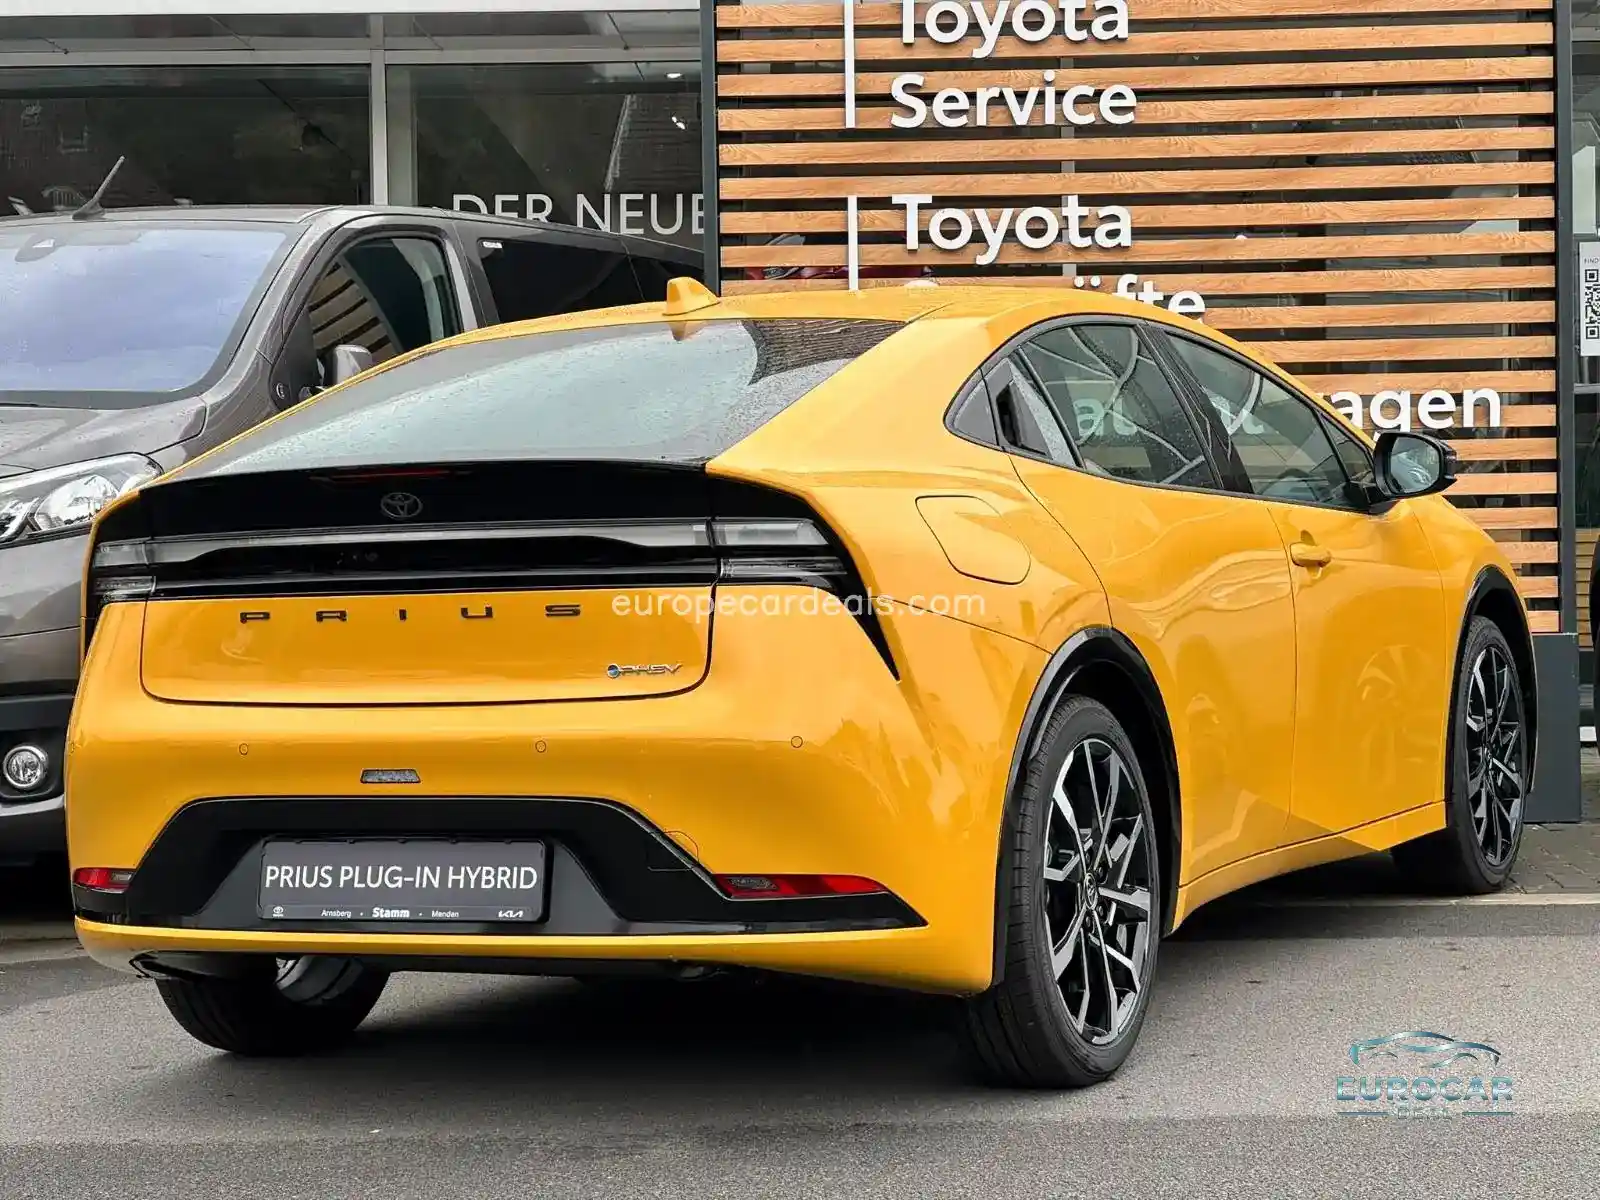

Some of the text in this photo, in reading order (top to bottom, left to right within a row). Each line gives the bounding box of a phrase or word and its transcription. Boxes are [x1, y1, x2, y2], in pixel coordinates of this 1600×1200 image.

[894, 0, 1130, 59] Toyota
[890, 70, 1138, 129] Service
[891, 194, 1133, 266] Toyota
[239, 604, 581, 623] PRIUS
[265, 865, 538, 890] PRIUS PLUG-IN HYBRID
[321, 907, 460, 919] Arnsberg Stamm Menden
